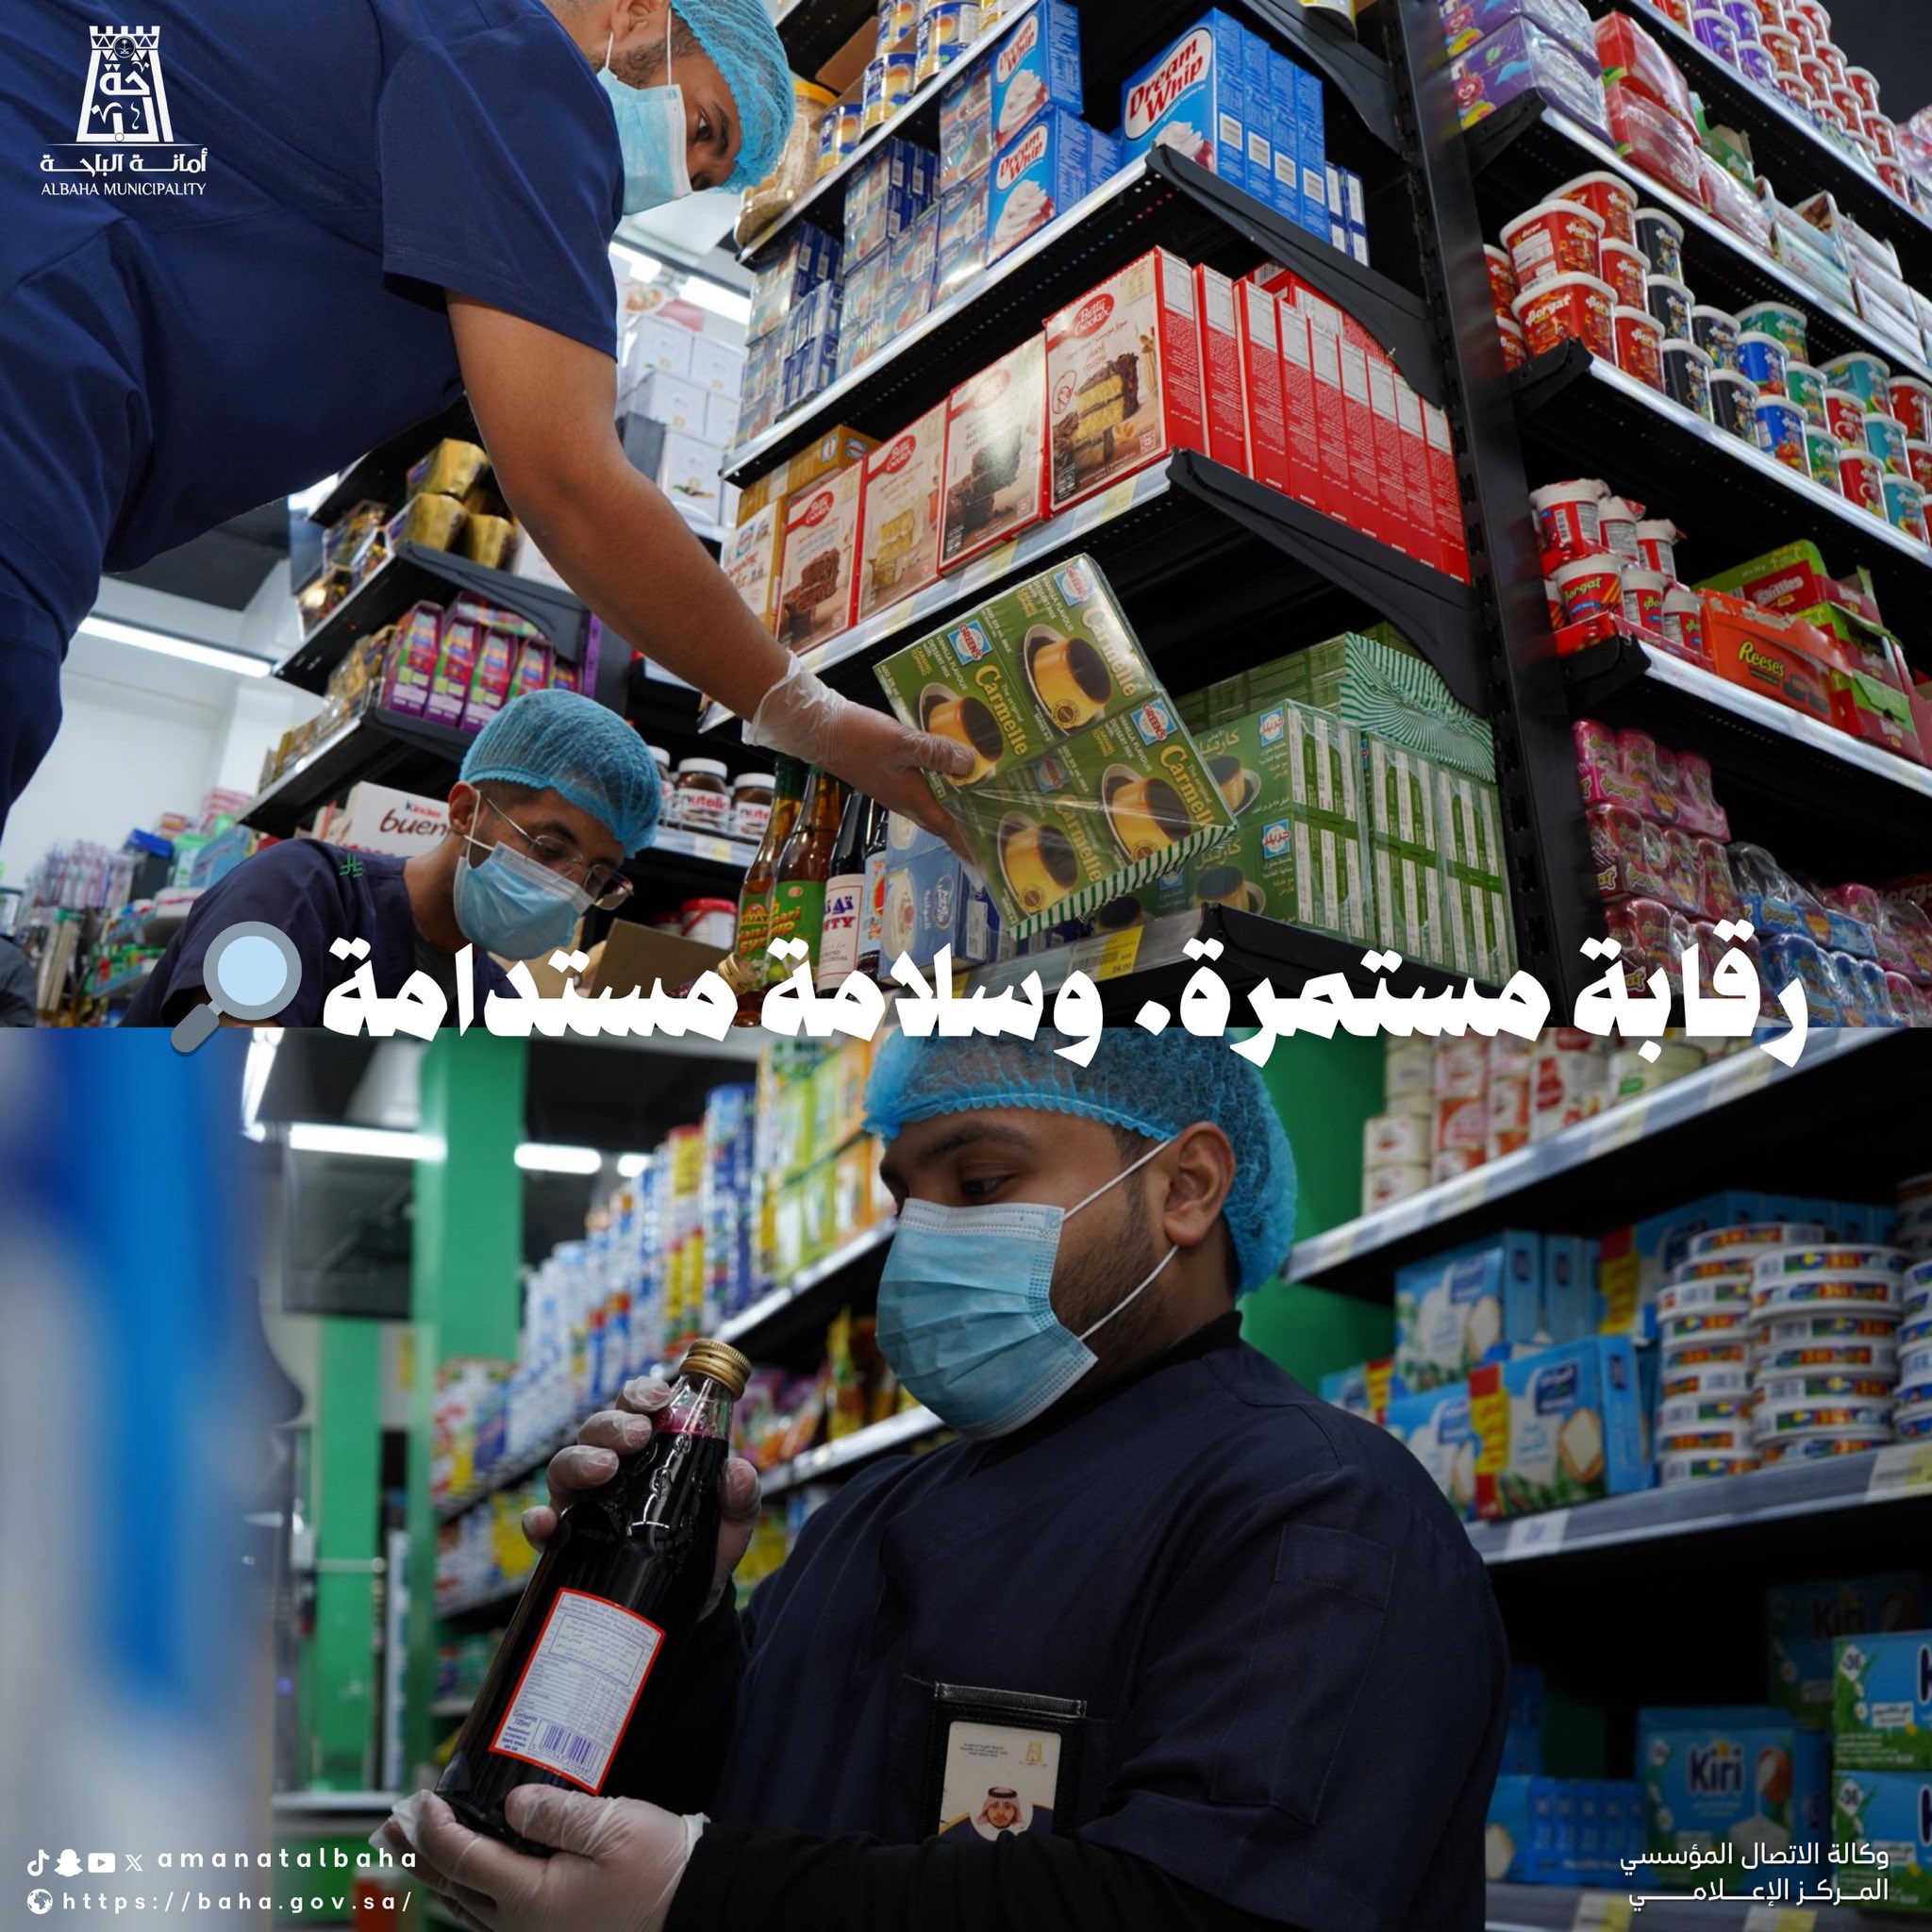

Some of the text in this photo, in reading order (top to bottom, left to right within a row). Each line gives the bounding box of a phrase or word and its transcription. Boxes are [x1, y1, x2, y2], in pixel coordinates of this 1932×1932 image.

[1130, 39, 1197, 121] Dream
[1146, 55, 1204, 123] Whip
[1000, 132, 1041, 178] Dream
[1009, 142, 1043, 181] Whip
[1080, 297, 1107, 321] Betty
[1525, 293, 1572, 326] Borgat
[1055, 603, 1074, 631] FLAVOUR
[921, 642, 932, 658] with
[926, 640, 951, 678] DESSERT MIX
[958, 624, 983, 661] GREEN'S
[1082, 605, 1138, 697] Carmelle
[935, 636, 967, 690] VANILLA FLAVOUR
[974, 664, 1028, 756] Carmelle
[999, 683, 1024, 723] The original
[1142, 704, 1167, 741] GREEN'S
[1109, 719, 1134, 759] DESSERT MIX
[1118, 715, 1152, 772] VANILLA FLAVOUR
[1187, 763, 1212, 804] The original
[379, 808, 453, 837] buen
[405, 799, 441, 818] kinder
[1688, 1744, 1744, 1794] Kiri
